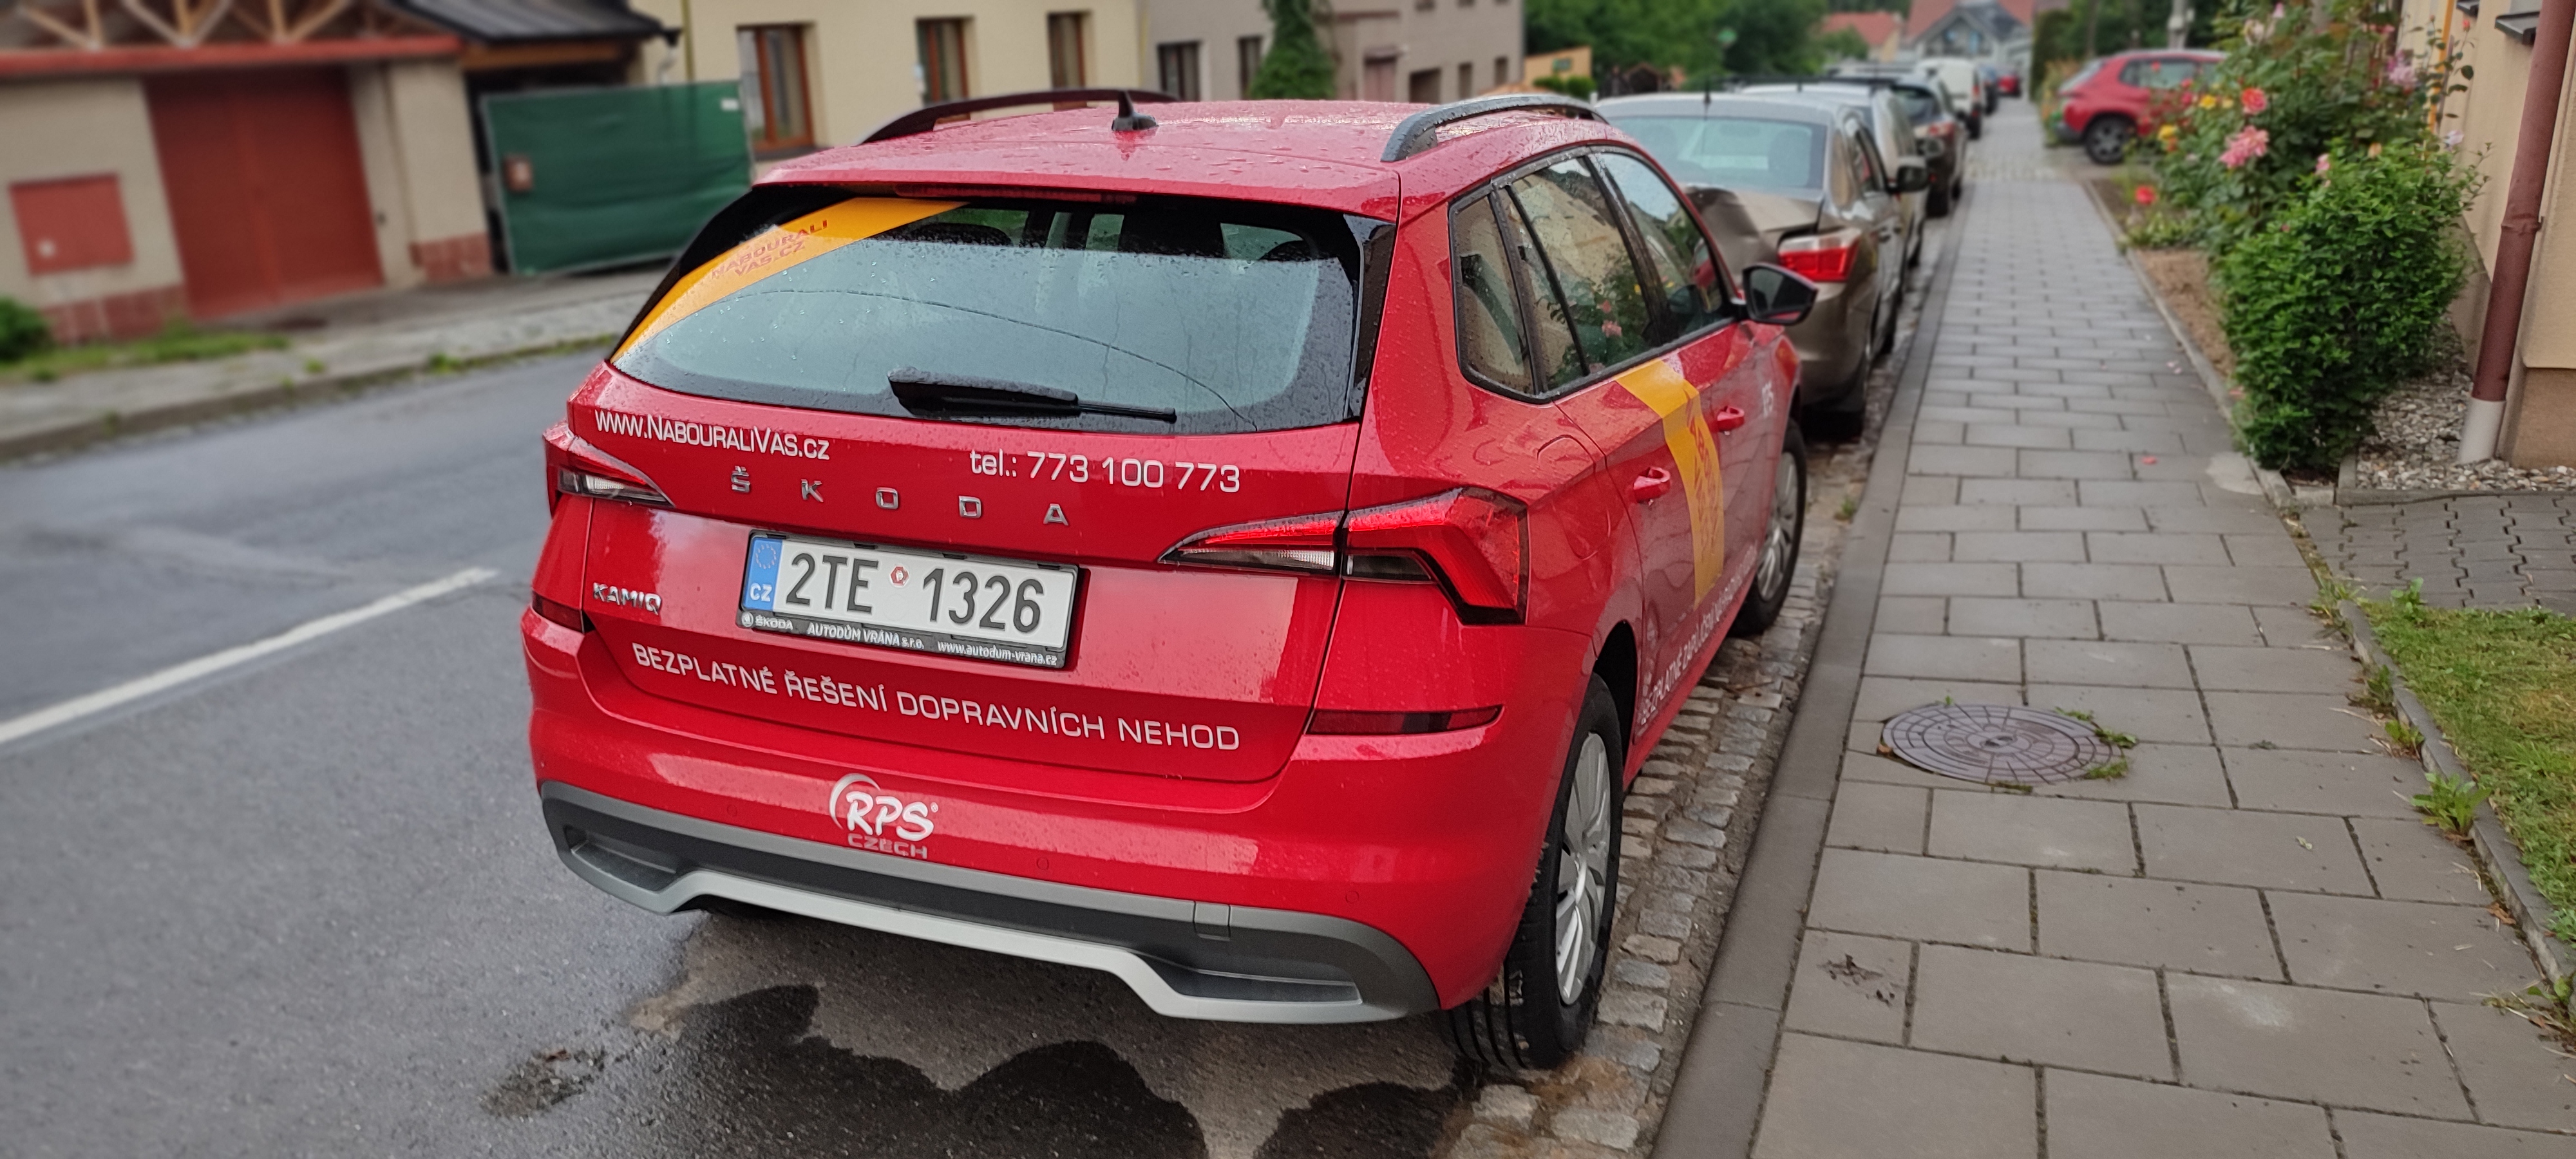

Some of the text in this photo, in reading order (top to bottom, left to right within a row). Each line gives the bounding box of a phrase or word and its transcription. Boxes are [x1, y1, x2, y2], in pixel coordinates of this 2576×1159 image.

[712, 220, 828, 279] NABOURALI
[969, 448, 1240, 492] tel.: 773 100 773
[731, 465, 1068, 526] ŠKODA
[592, 582, 661, 616] KAMIQ
[750, 583, 773, 602] CZ
[785, 552, 1045, 633] 2TE 1326
[755, 614, 793, 630] ŠKODA
[808, 622, 925, 649] AUTODŮM VRÁNA s.r.o.
[937, 641, 1057, 666] www.autodum-vrana.cz
[632, 643, 1240, 751] BEZPLATNÉ ŘEŠENÍ DOPRAVNÍCH NEHOD
[848, 833, 928, 859] CZECH
